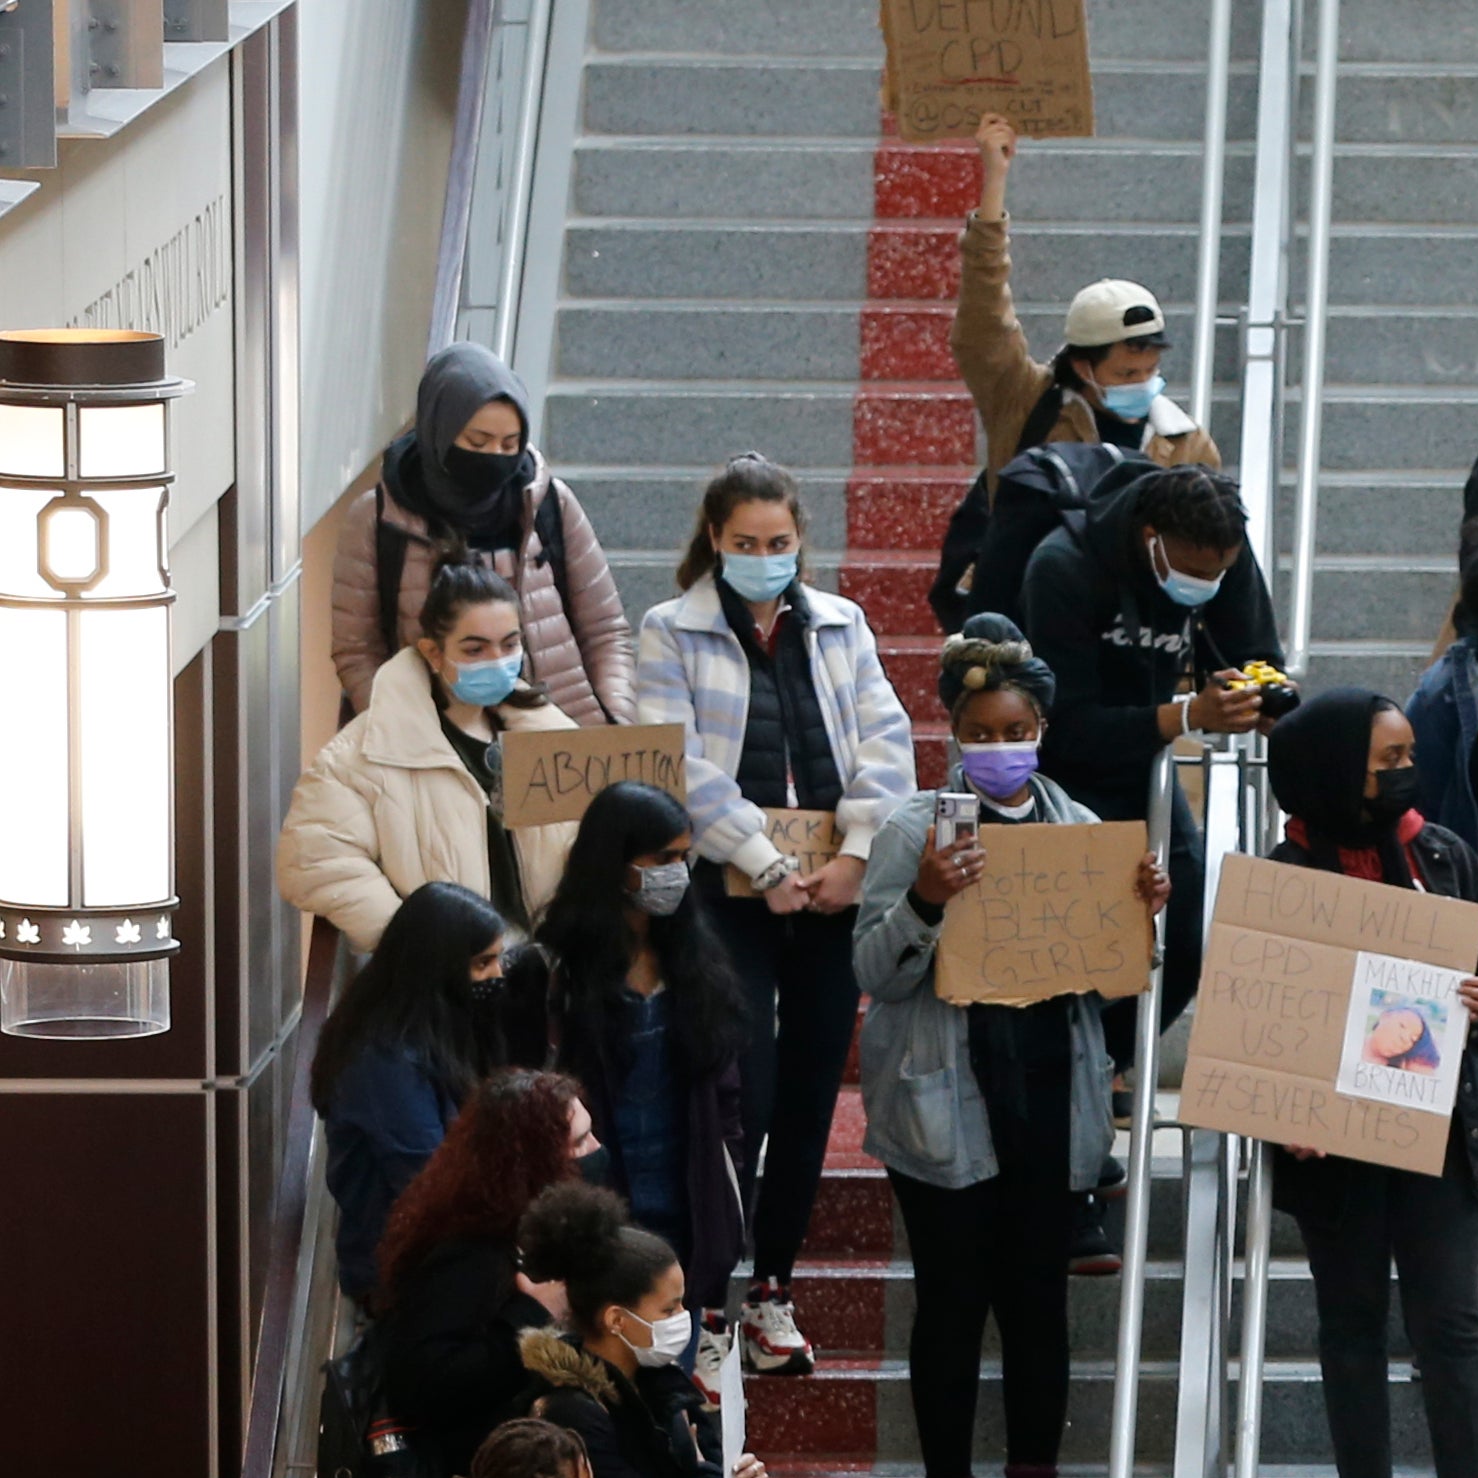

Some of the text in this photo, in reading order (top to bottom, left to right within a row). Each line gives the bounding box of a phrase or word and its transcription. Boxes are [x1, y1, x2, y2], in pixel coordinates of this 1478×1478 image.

[940, 38, 1024, 78] CPD
[769, 817, 826, 845] ACK
[981, 898, 1122, 943] BLACK
[1242, 864, 1452, 950] HOW WILL
[981, 939, 1125, 988] GIRLS
[1229, 932, 1313, 976] CPD
[1211, 969, 1341, 1025] PROTECT
[1241, 1015, 1310, 1058] US?
[1352, 1062, 1442, 1106] BRYANT
[1197, 1066, 1421, 1150] #SEVER TIES
